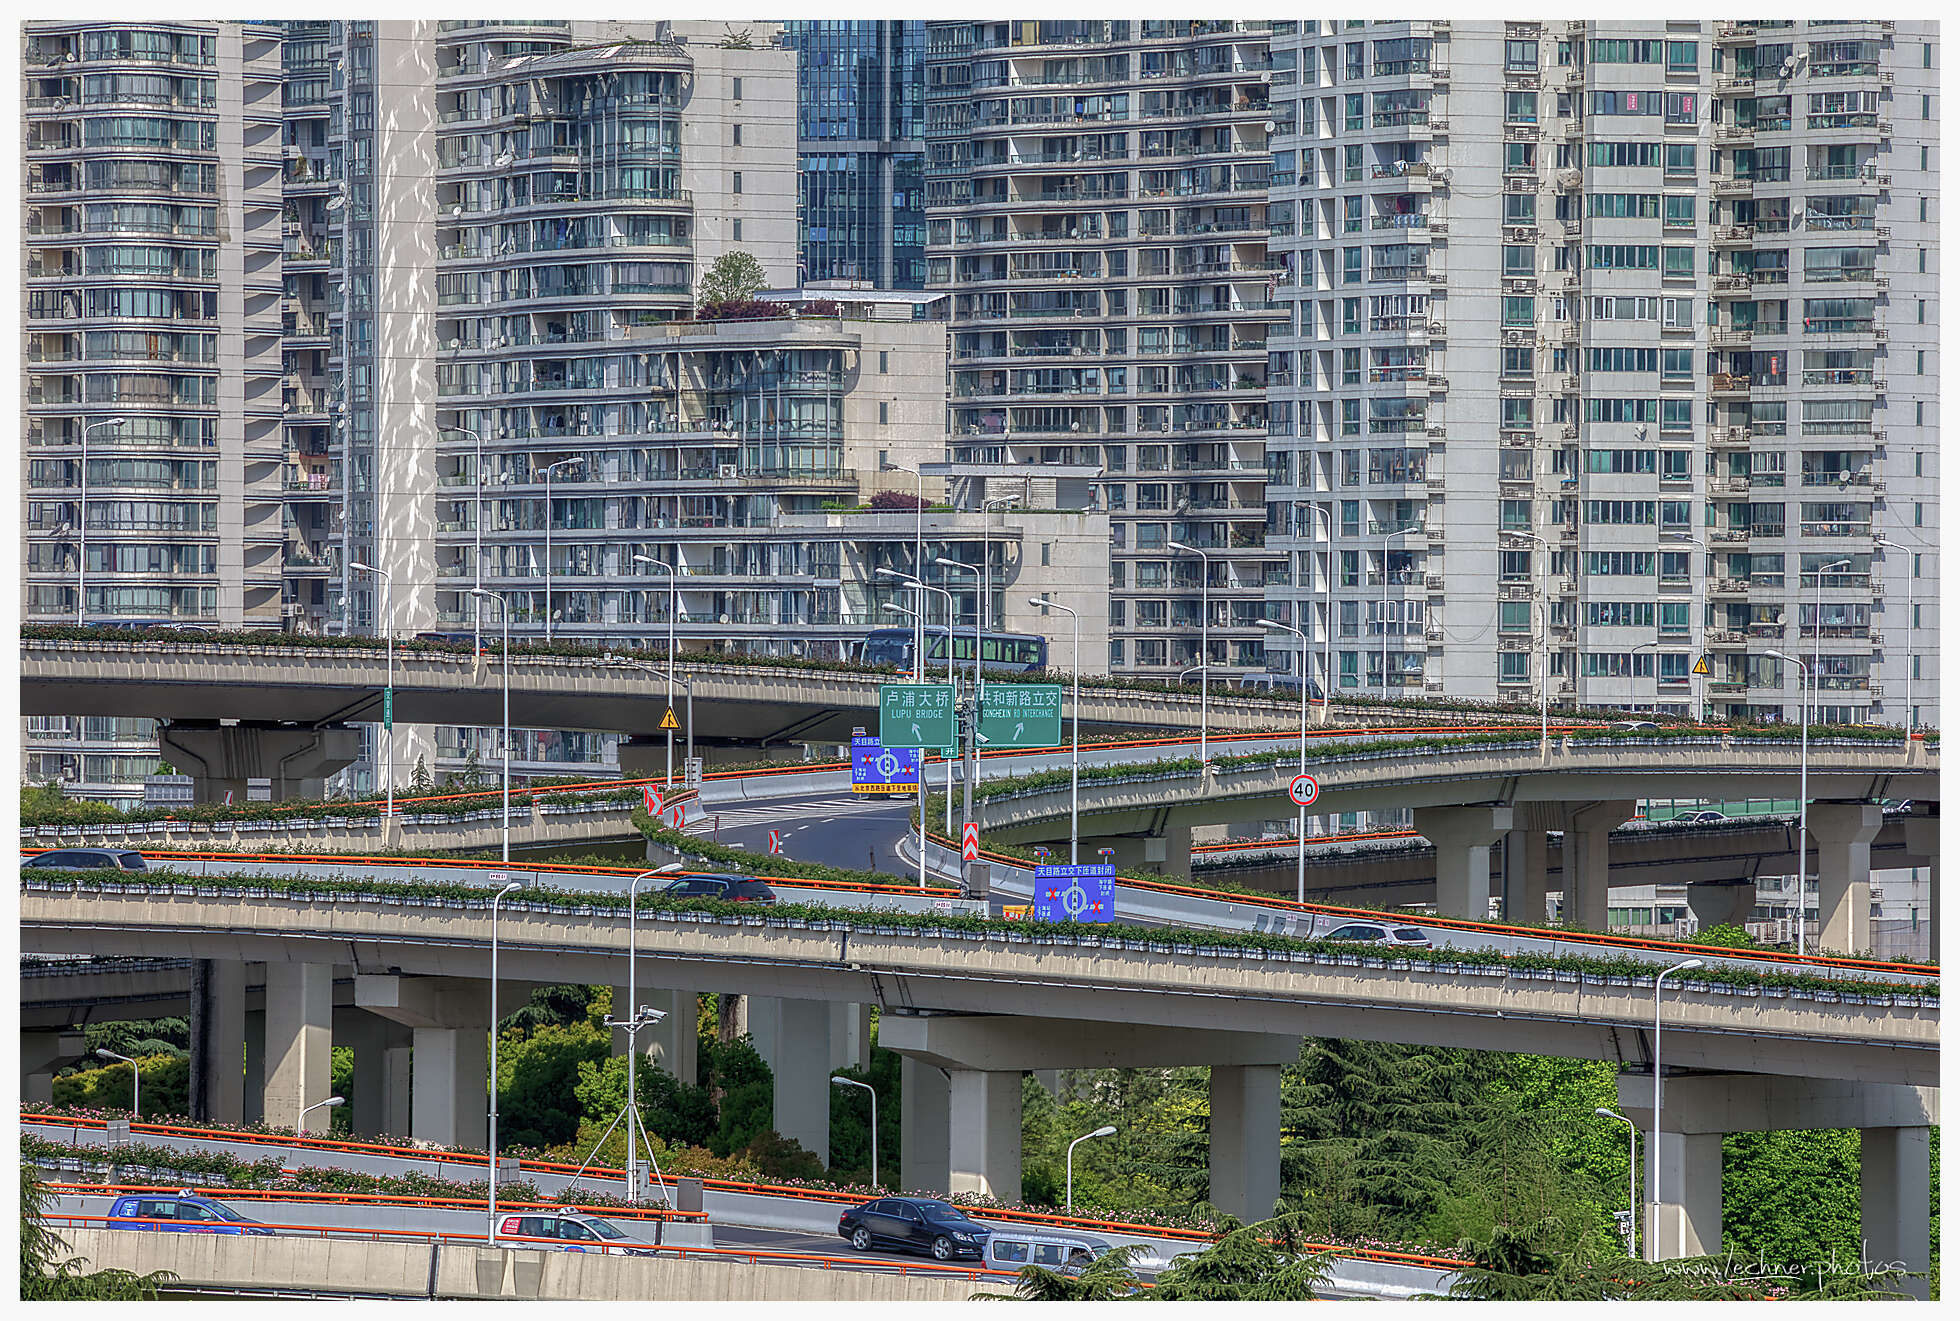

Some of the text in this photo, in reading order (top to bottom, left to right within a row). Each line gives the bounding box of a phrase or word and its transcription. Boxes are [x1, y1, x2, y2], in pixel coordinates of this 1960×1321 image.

[886, 690, 949, 707] 卢浦大桥
[983, 690, 1058, 706] 共和新路立交
[891, 709, 944, 719] LUPU BRIDGE
[1294, 783, 1314, 798] 40
[1038, 866, 1112, 876] 天目路立交下匝道封闭
